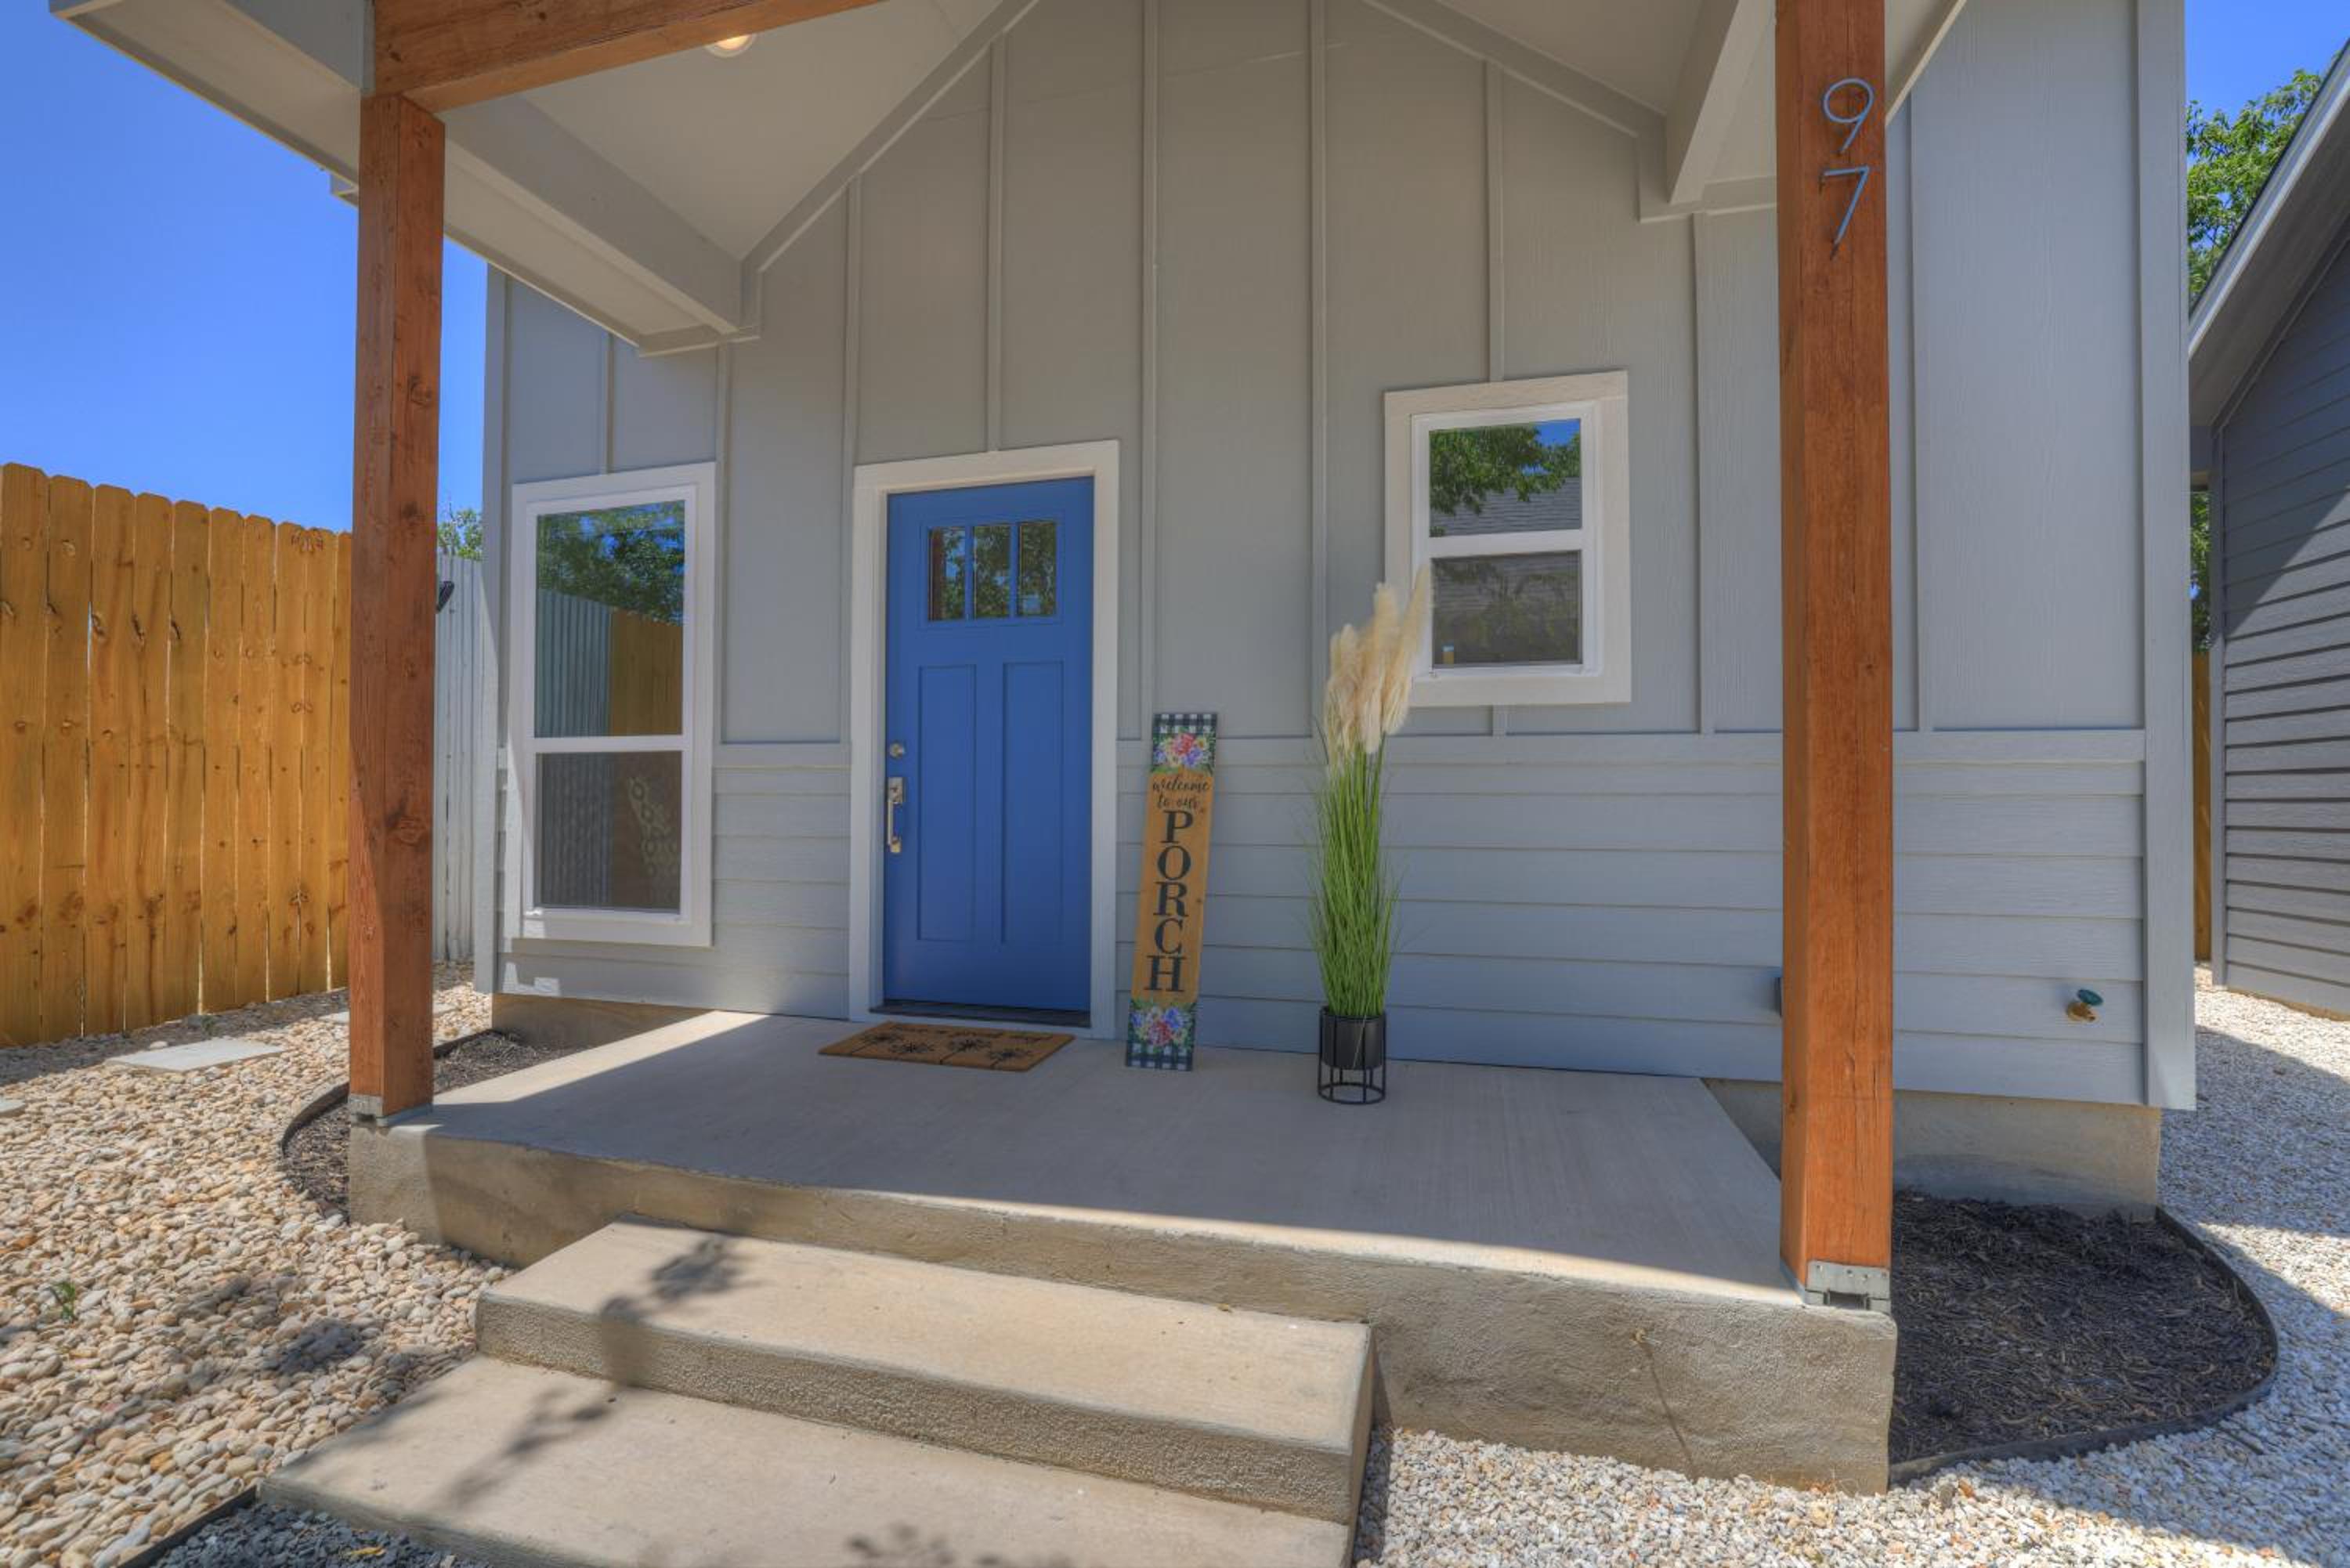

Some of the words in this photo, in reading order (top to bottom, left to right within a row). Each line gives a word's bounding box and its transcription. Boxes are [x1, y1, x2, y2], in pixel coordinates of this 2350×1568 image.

[1823, 78, 1874, 258] 97
[1152, 775, 1209, 792] welcome
[1157, 792, 1170, 808] to
[1176, 796, 1200, 808] our
[1144, 810, 1193, 992] PORCH
